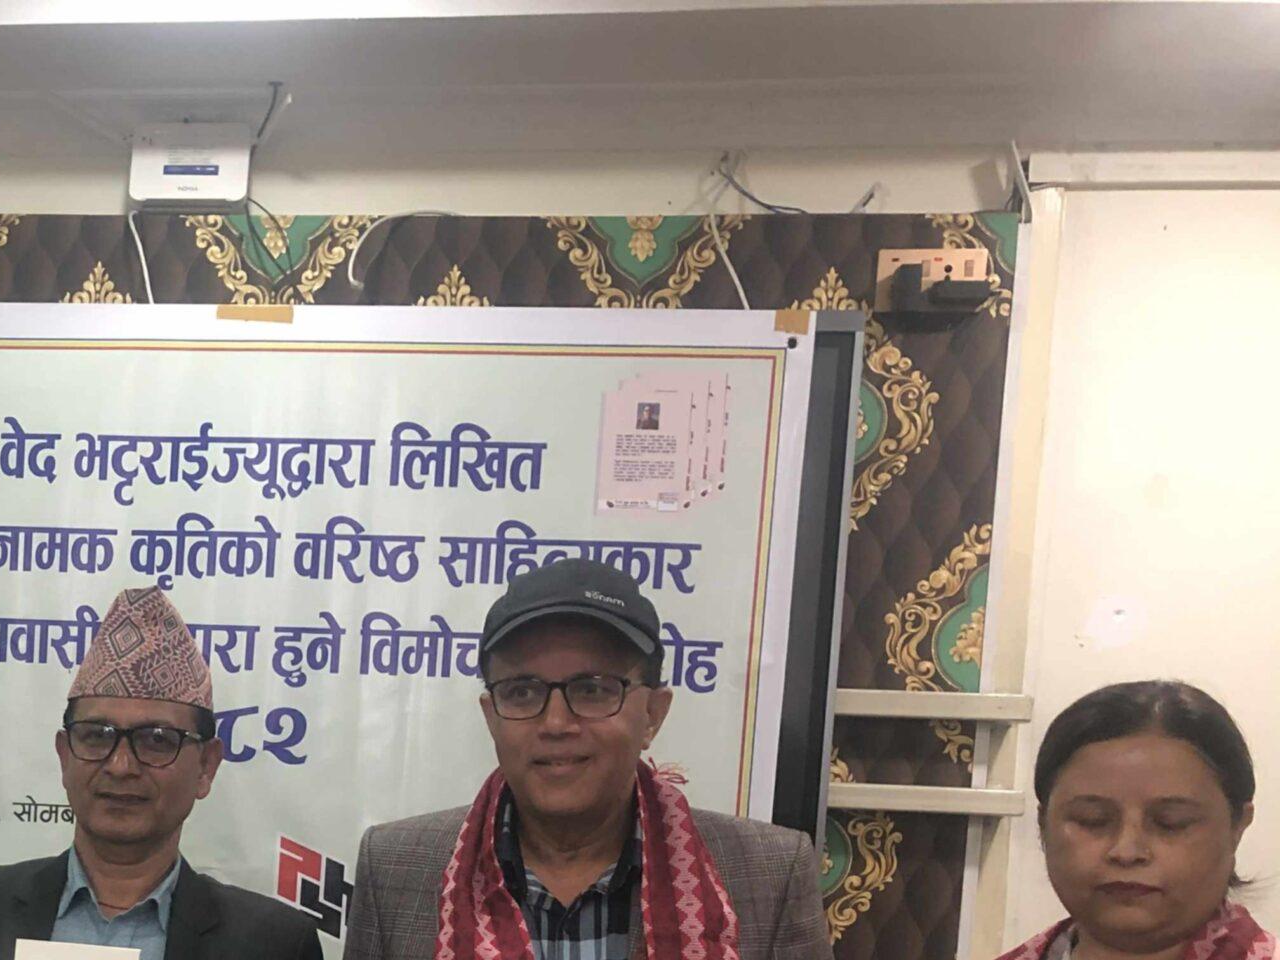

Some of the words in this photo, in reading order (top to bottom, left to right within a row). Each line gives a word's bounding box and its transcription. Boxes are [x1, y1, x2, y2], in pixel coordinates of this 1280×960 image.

[0, 416, 62, 484] वेद
[389, 421, 548, 492] लिखित
[130, 512, 282, 591] कृतिको
[294, 515, 426, 584] वरिष्ठ
[272, 611, 347, 688] हुने
